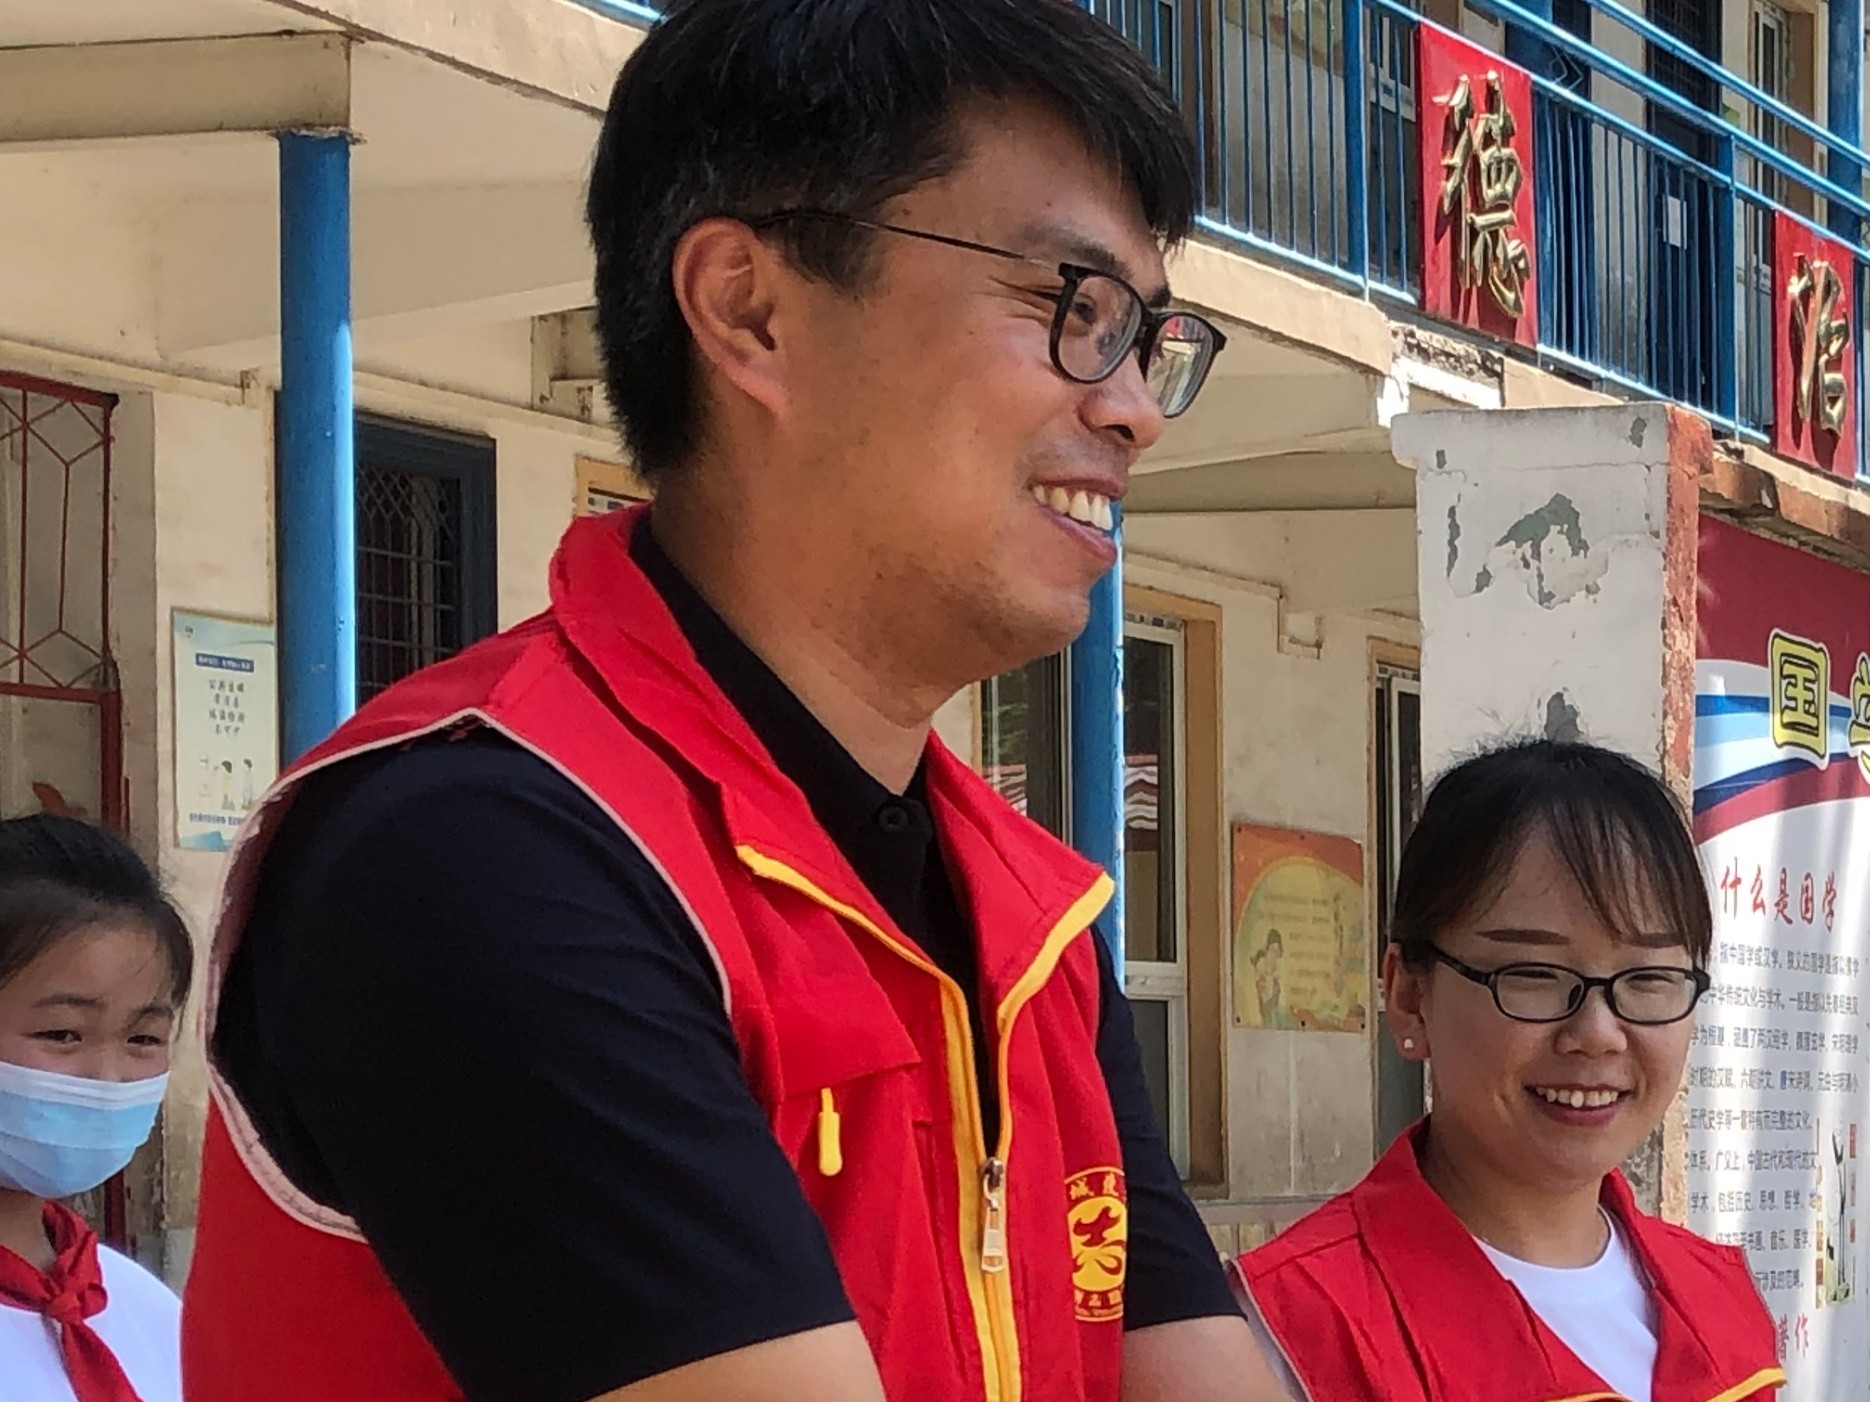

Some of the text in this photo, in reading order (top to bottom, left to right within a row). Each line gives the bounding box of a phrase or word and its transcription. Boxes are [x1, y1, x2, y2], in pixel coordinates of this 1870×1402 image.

[1433, 71, 1529, 318] 德
[1721, 857, 1836, 932] 什么是国学
